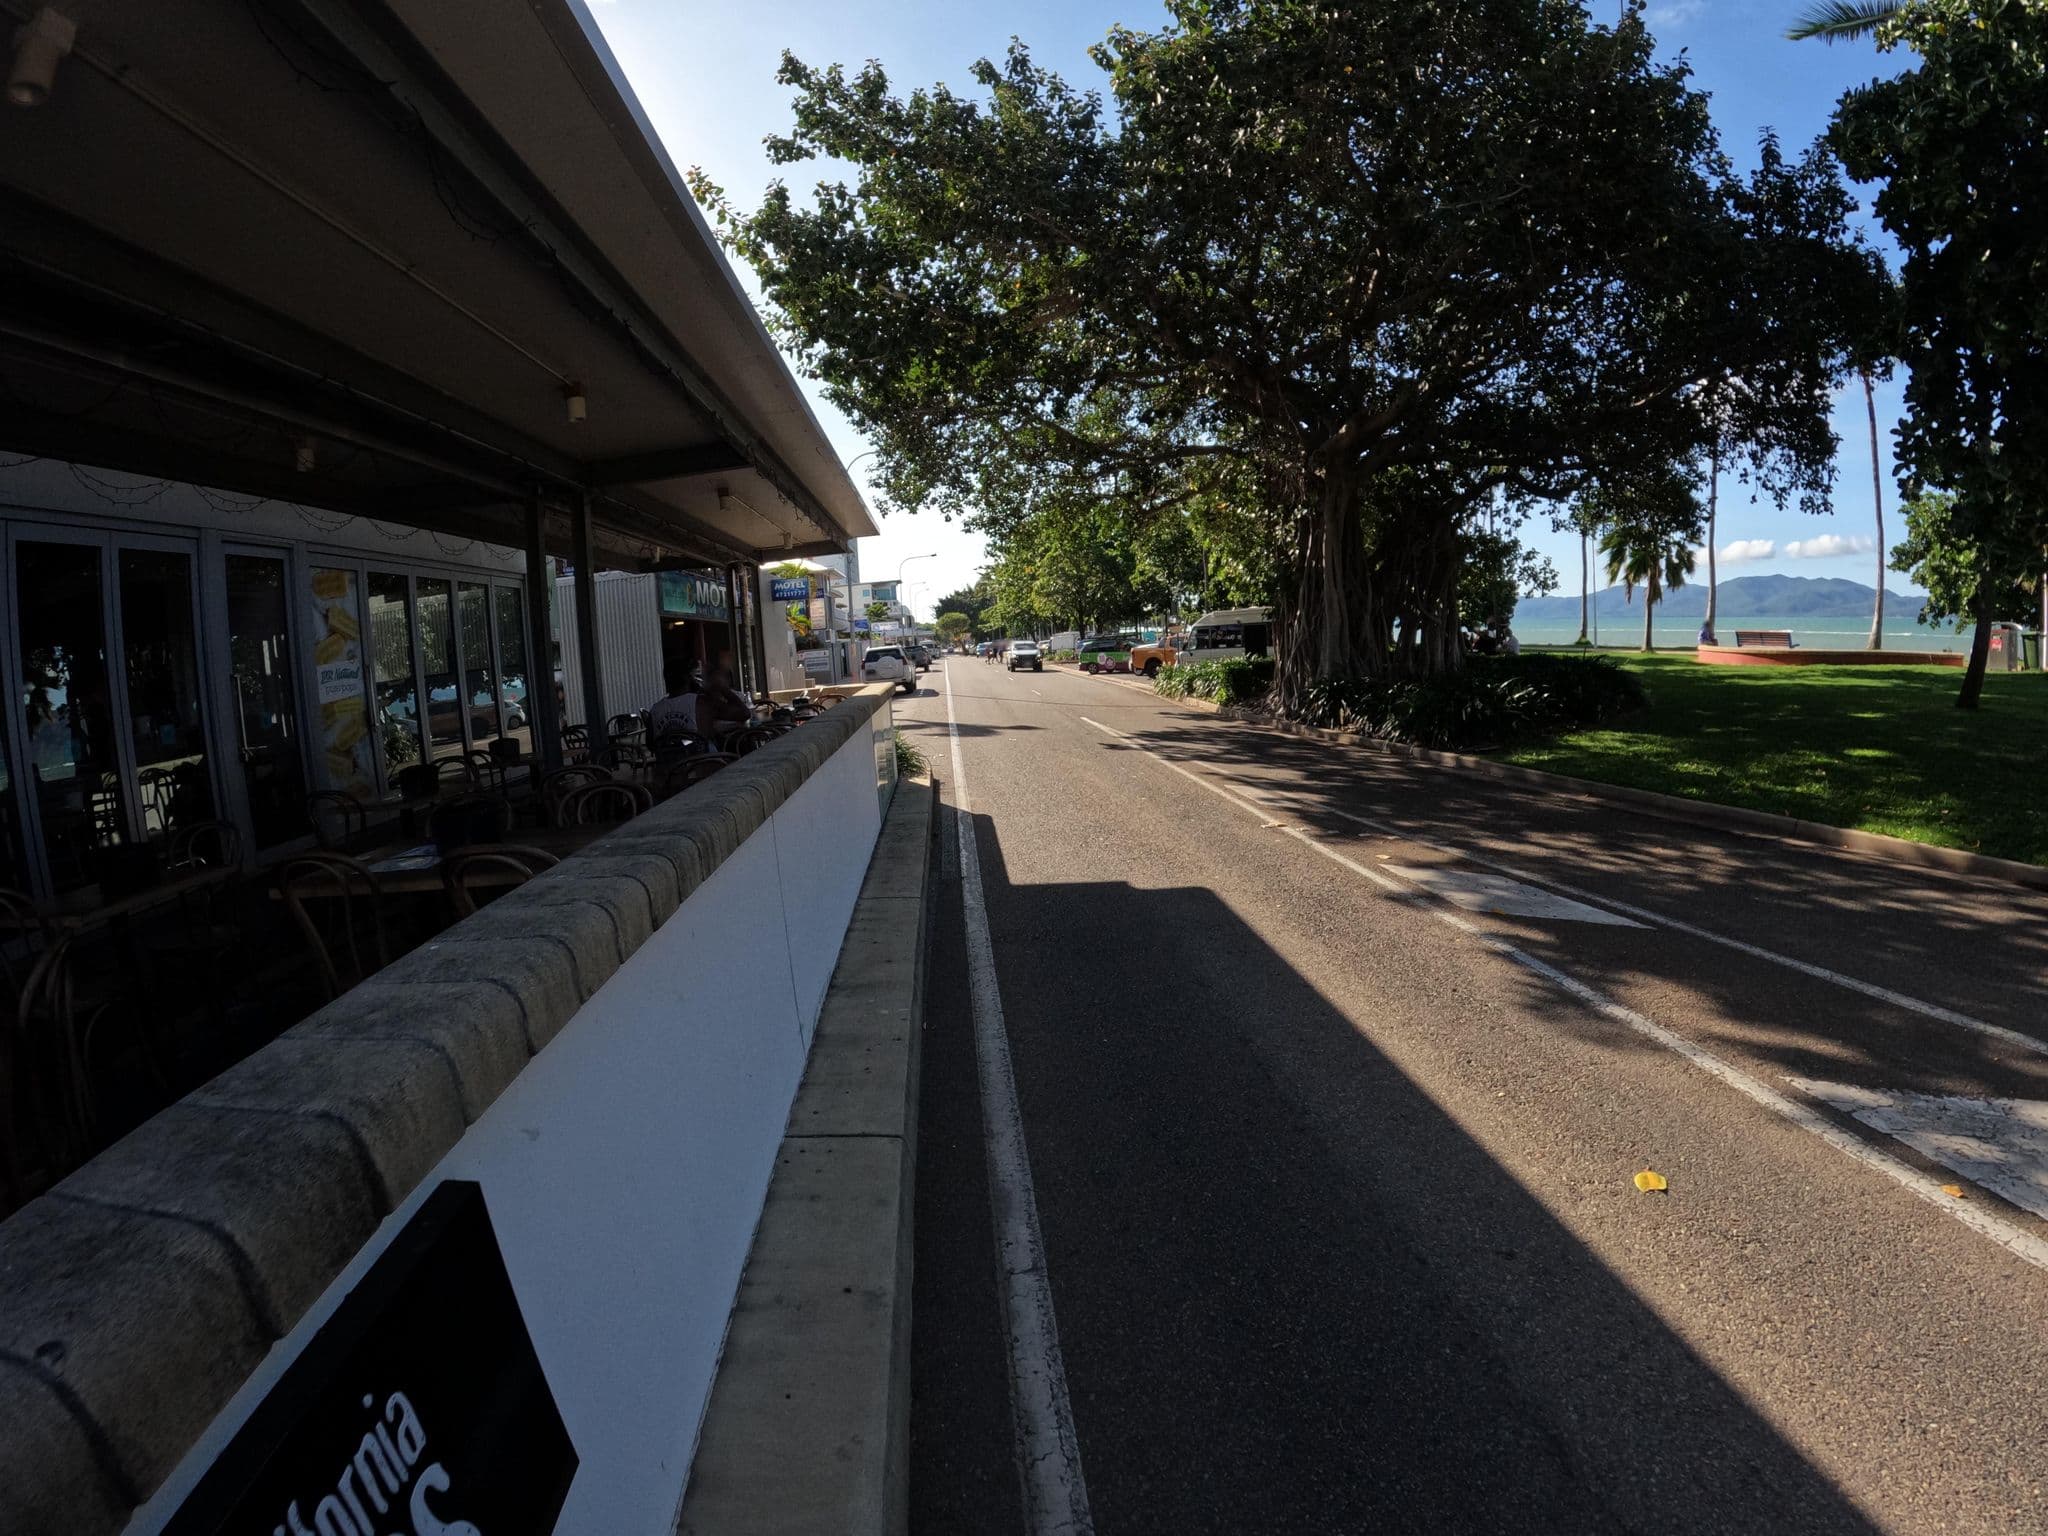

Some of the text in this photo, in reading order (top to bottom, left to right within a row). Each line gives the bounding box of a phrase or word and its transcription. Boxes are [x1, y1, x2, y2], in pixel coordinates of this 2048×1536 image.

[696, 580, 727, 608] MOT
[774, 581, 806, 591] MOTEL
[273, 1390, 427, 1536] fornia
